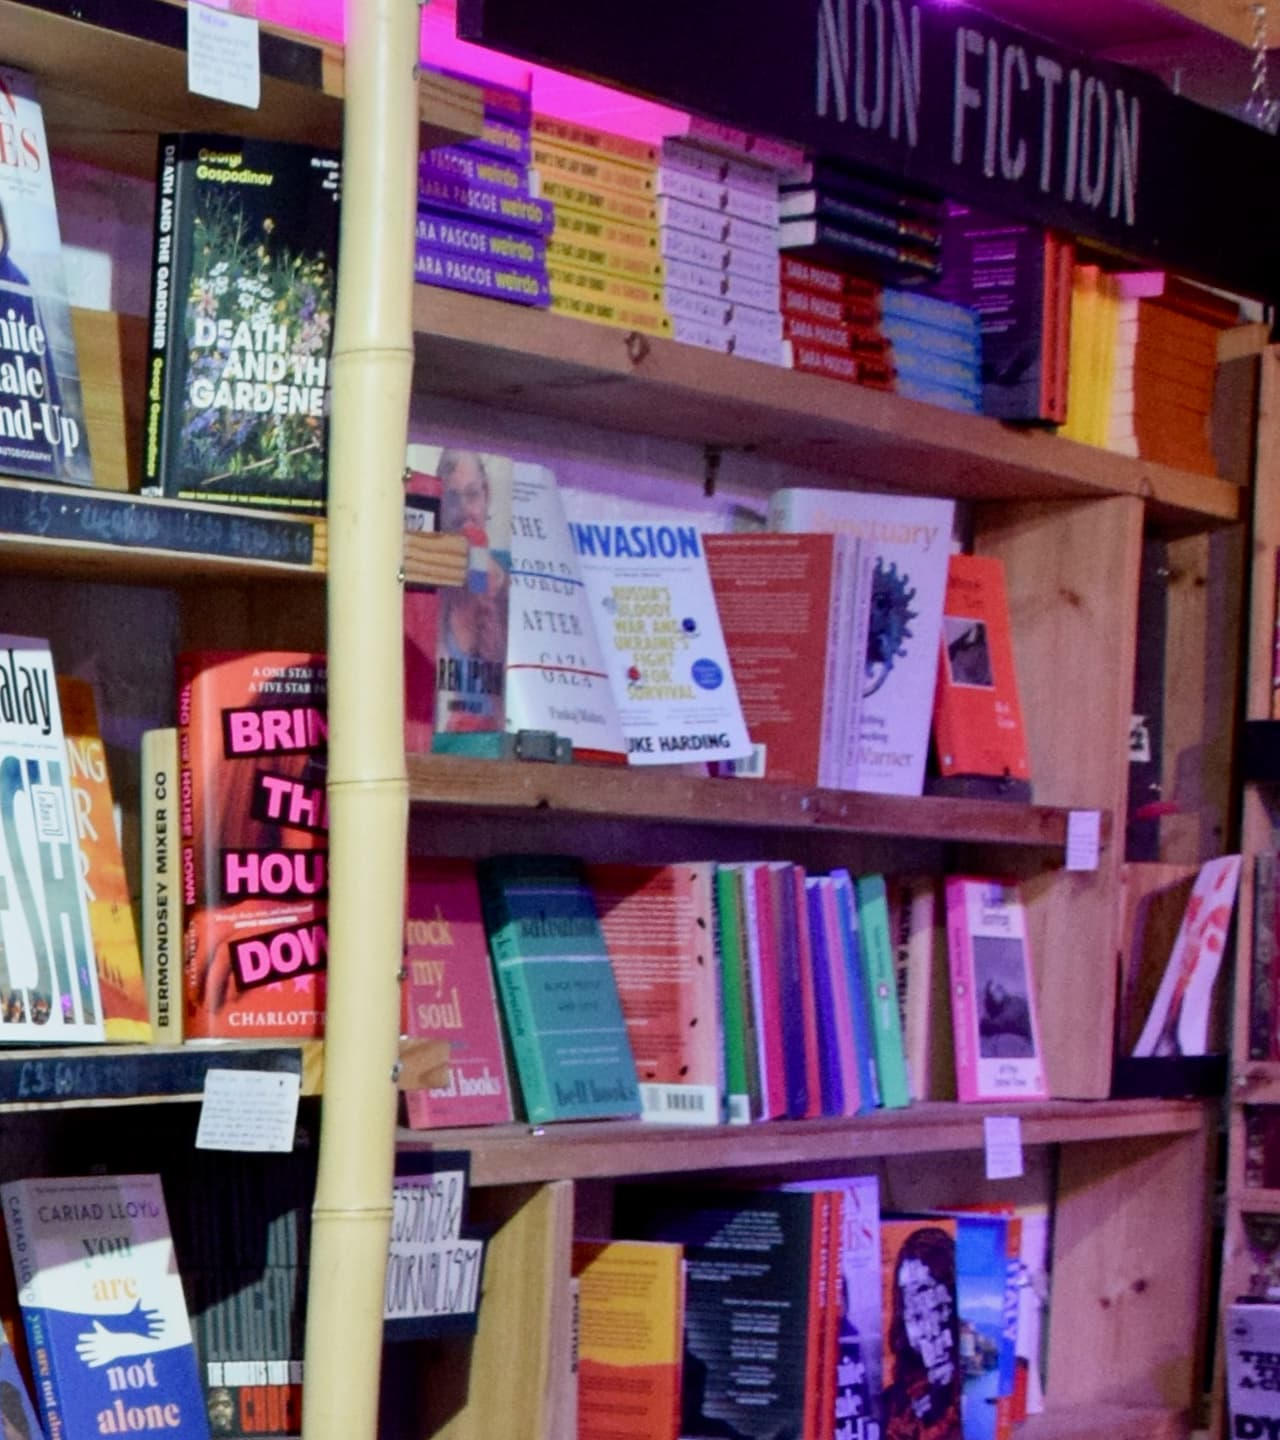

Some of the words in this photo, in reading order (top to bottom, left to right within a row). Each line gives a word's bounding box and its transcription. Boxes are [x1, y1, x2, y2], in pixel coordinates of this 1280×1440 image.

[950, 26, 1142, 229] FICTION
[198, 148, 242, 164] Georgi
[196, 165, 274, 186] Gospodinov
[447, 261, 492, 286] PASCOE
[495, 271, 539, 295] weirdo
[195, 318, 288, 352] DEATH
[222, 351, 286, 383] AND
[288, 354, 326, 387] TH
[190, 380, 324, 417] GARDENE
[567, 522, 701, 559] INVASION
[627, 734, 654, 753] UKE
[659, 733, 731, 751] HARDING
[154, 771, 167, 801] CO
[156, 810, 167, 874] MIXER
[156, 883, 169, 1028] BERMONDSEY
[38, 1202, 104, 1223] CARIAD
[110, 1200, 159, 1219] LLOYD
[81, 1236, 134, 1269] you
[92, 1276, 138, 1302] are
[107, 1357, 160, 1391] not
[97, 1399, 181, 1435] alone
